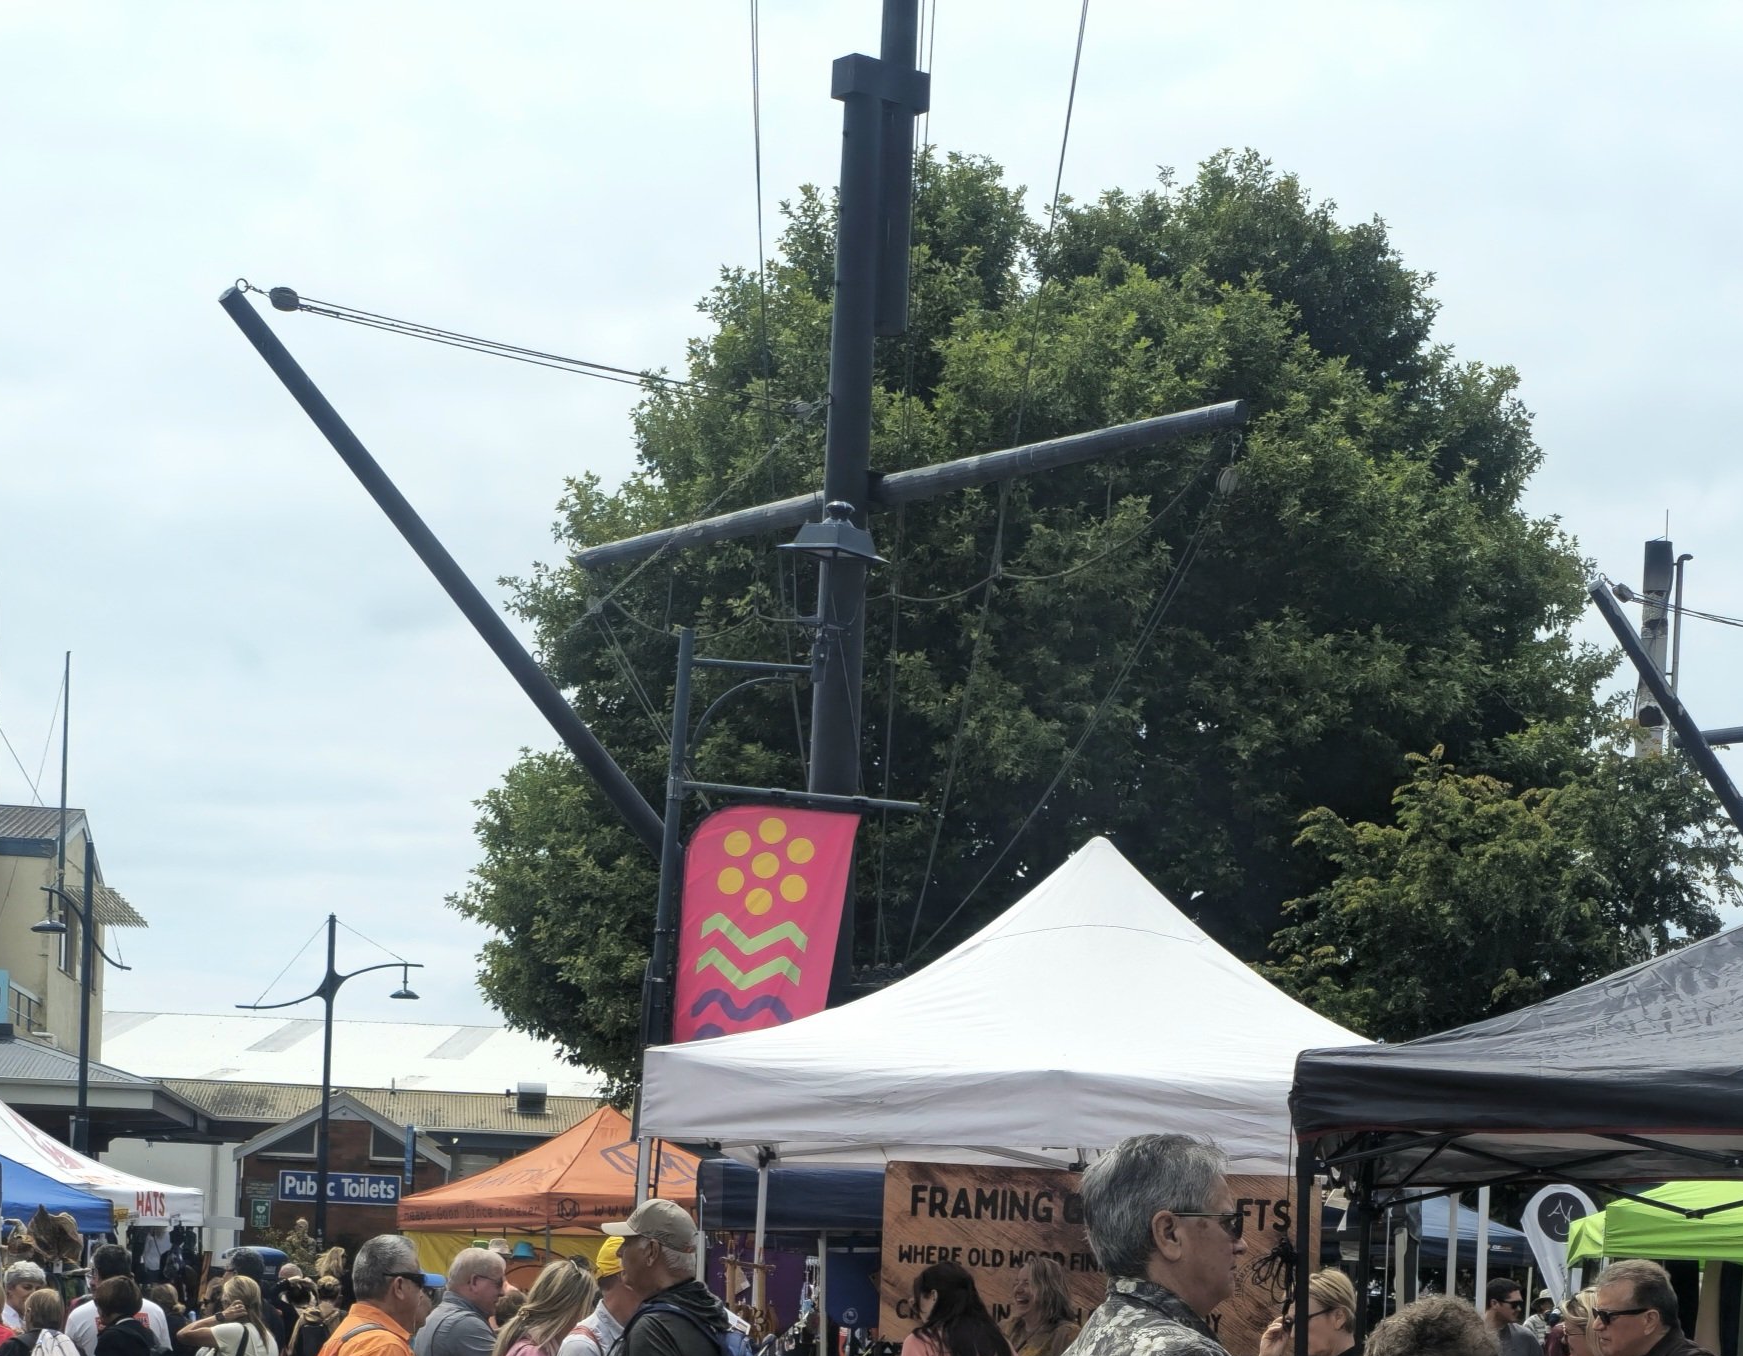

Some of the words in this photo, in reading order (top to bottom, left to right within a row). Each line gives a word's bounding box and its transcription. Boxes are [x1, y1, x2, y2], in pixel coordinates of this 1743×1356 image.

[284, 1175, 335, 1197] Pubc
[341, 1177, 395, 1199] Toilets
[136, 1190, 165, 1217] HATS
[465, 1204, 493, 1219] Since
[911, 1184, 1053, 1224] FRAMING
[898, 1244, 963, 1265] WHERE
[968, 1247, 1005, 1268] OLD
